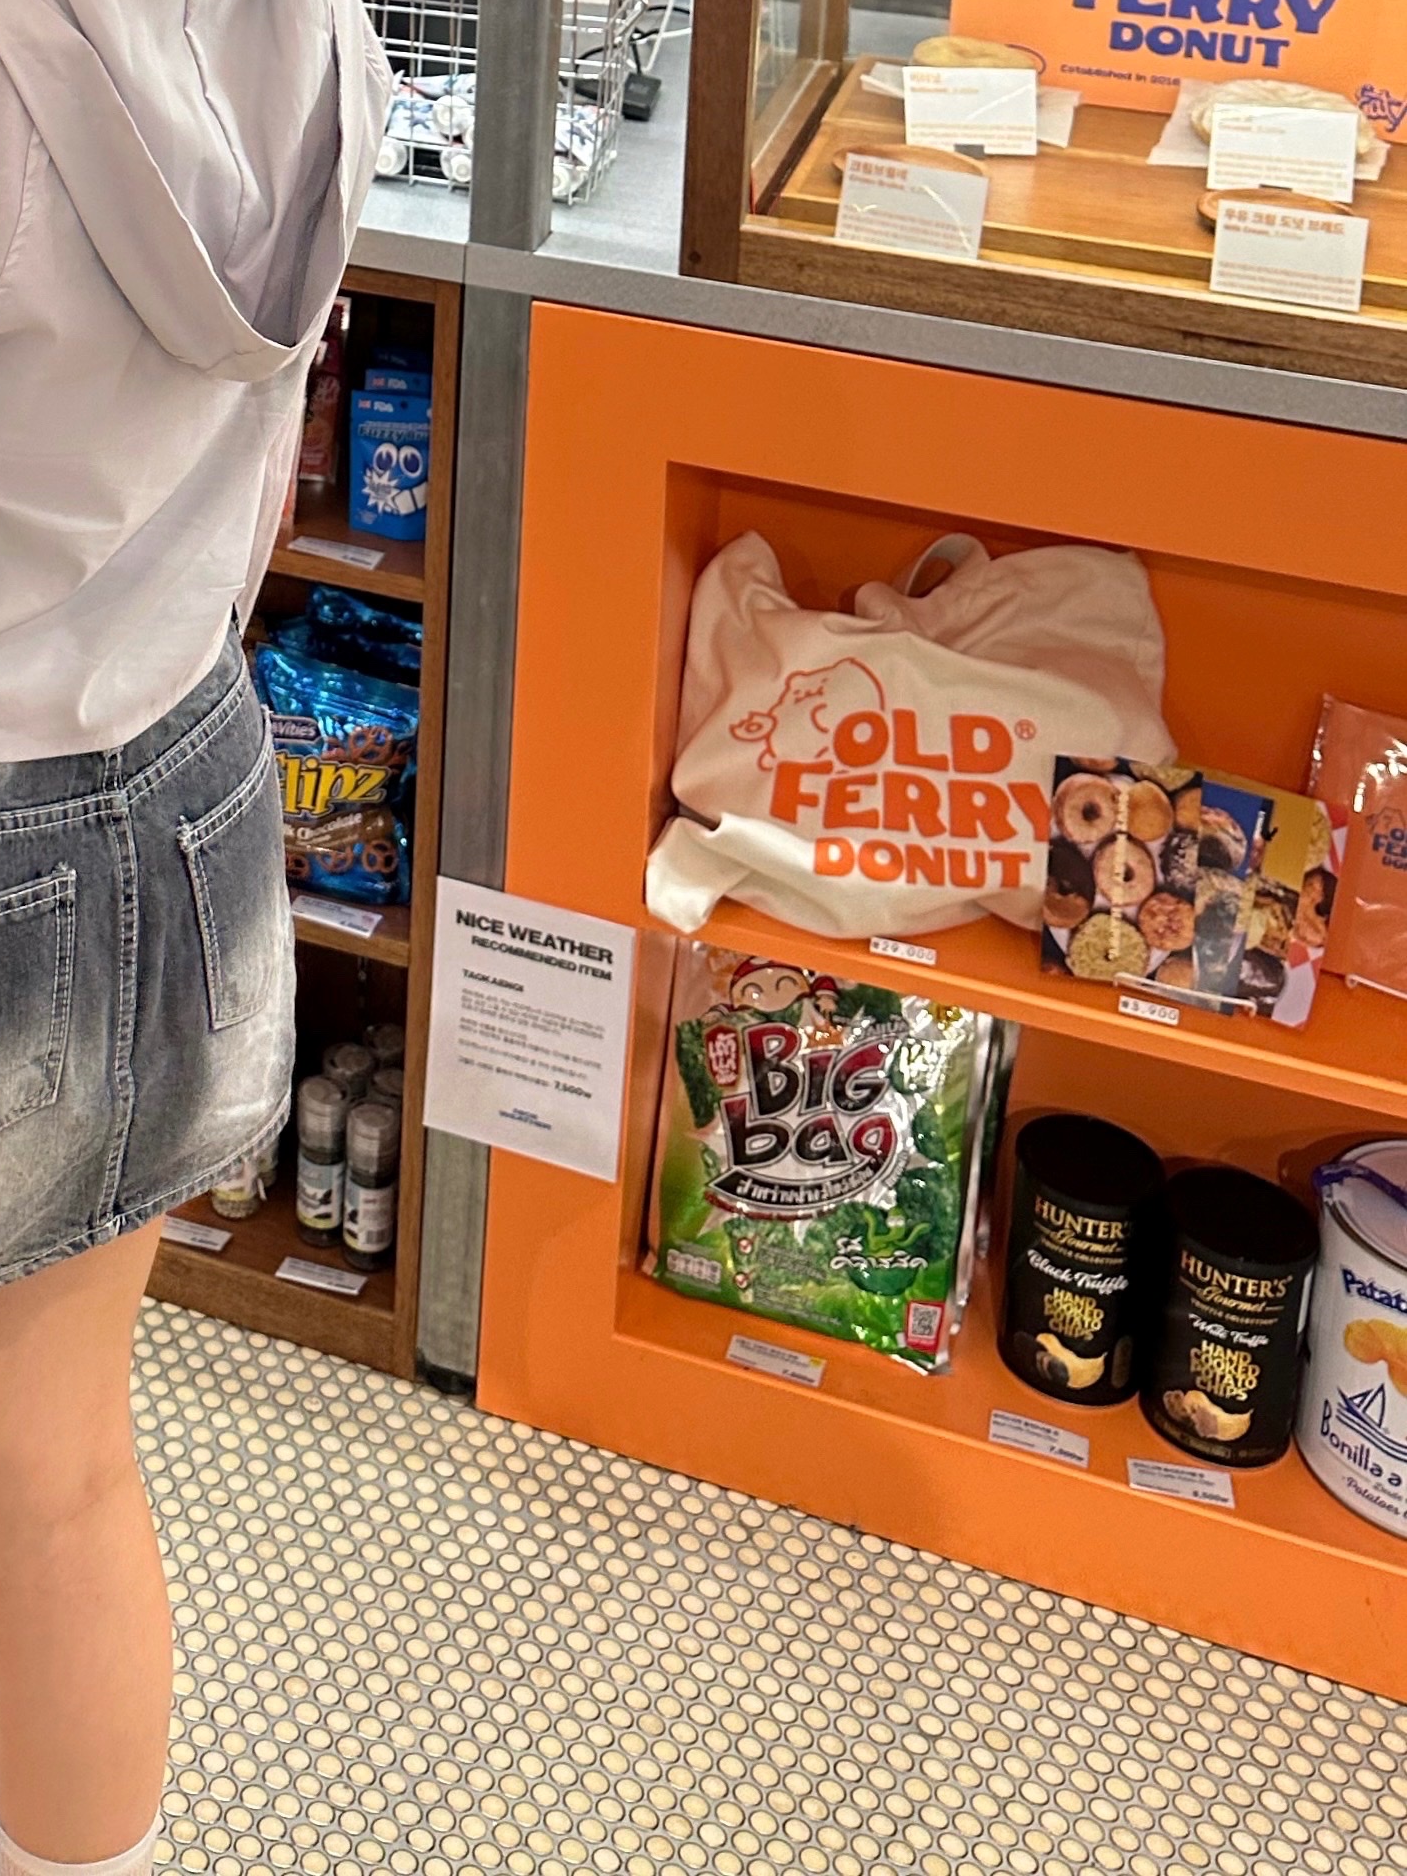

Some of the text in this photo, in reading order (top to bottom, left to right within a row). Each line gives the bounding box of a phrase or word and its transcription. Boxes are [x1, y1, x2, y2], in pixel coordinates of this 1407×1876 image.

[1109, 20, 1290, 69] DONUT
[832, 707, 1014, 775] OLD
[813, 836, 1031, 890] DONUT
[455, 908, 614, 965] NICE WEATHER
[471, 935, 613, 981] RECOMMENDED ITEM
[743, 1021, 896, 1118] BIG
[720, 1091, 899, 1176] bag
[1181, 1249, 1288, 1299] HUNTER'S
[1320, 1398, 1384, 1479] Bonilla
